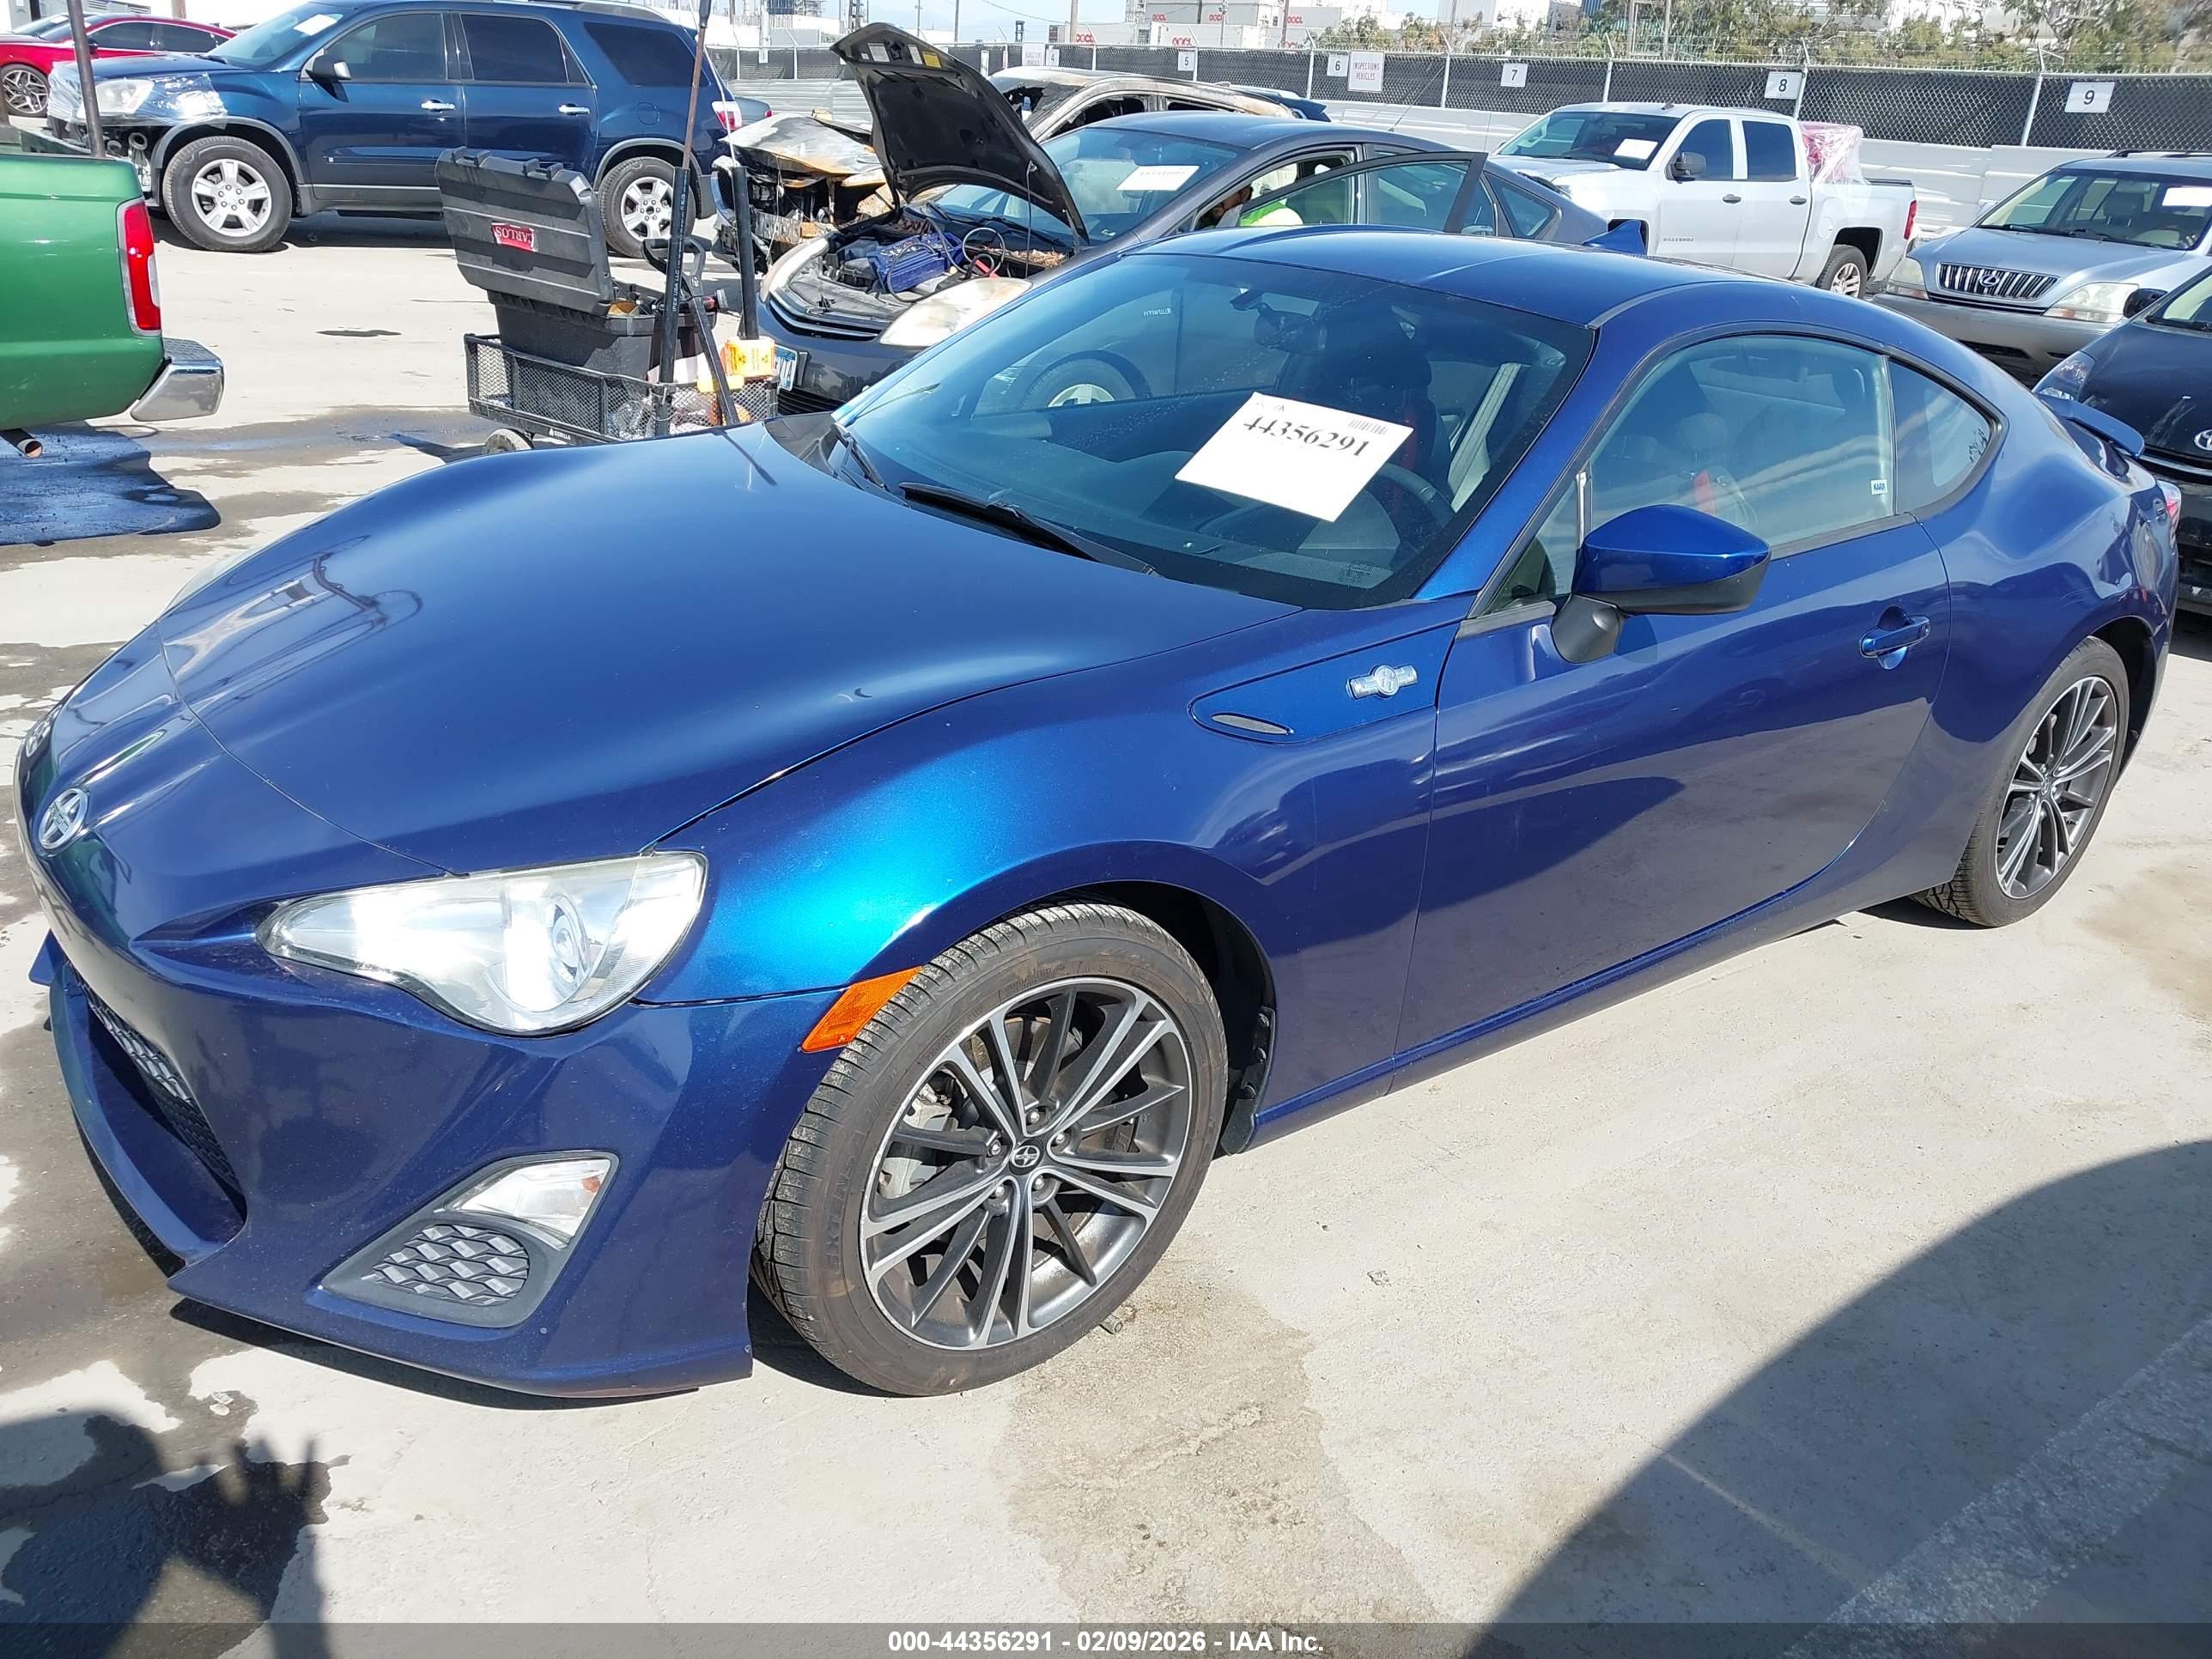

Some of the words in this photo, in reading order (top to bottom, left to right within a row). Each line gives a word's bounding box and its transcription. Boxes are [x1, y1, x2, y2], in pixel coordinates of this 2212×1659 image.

[1050, 52, 1055, 63] 4
[1184, 57, 1189, 66] 5
[1334, 60, 1341, 71] 6
[1356, 72, 1376, 81] VEHICLES
[1511, 69, 1518, 82] 7
[1778, 78, 1788, 92] 8
[2083, 89, 2095, 105] 9
[1243, 416, 1370, 457] 44356291
